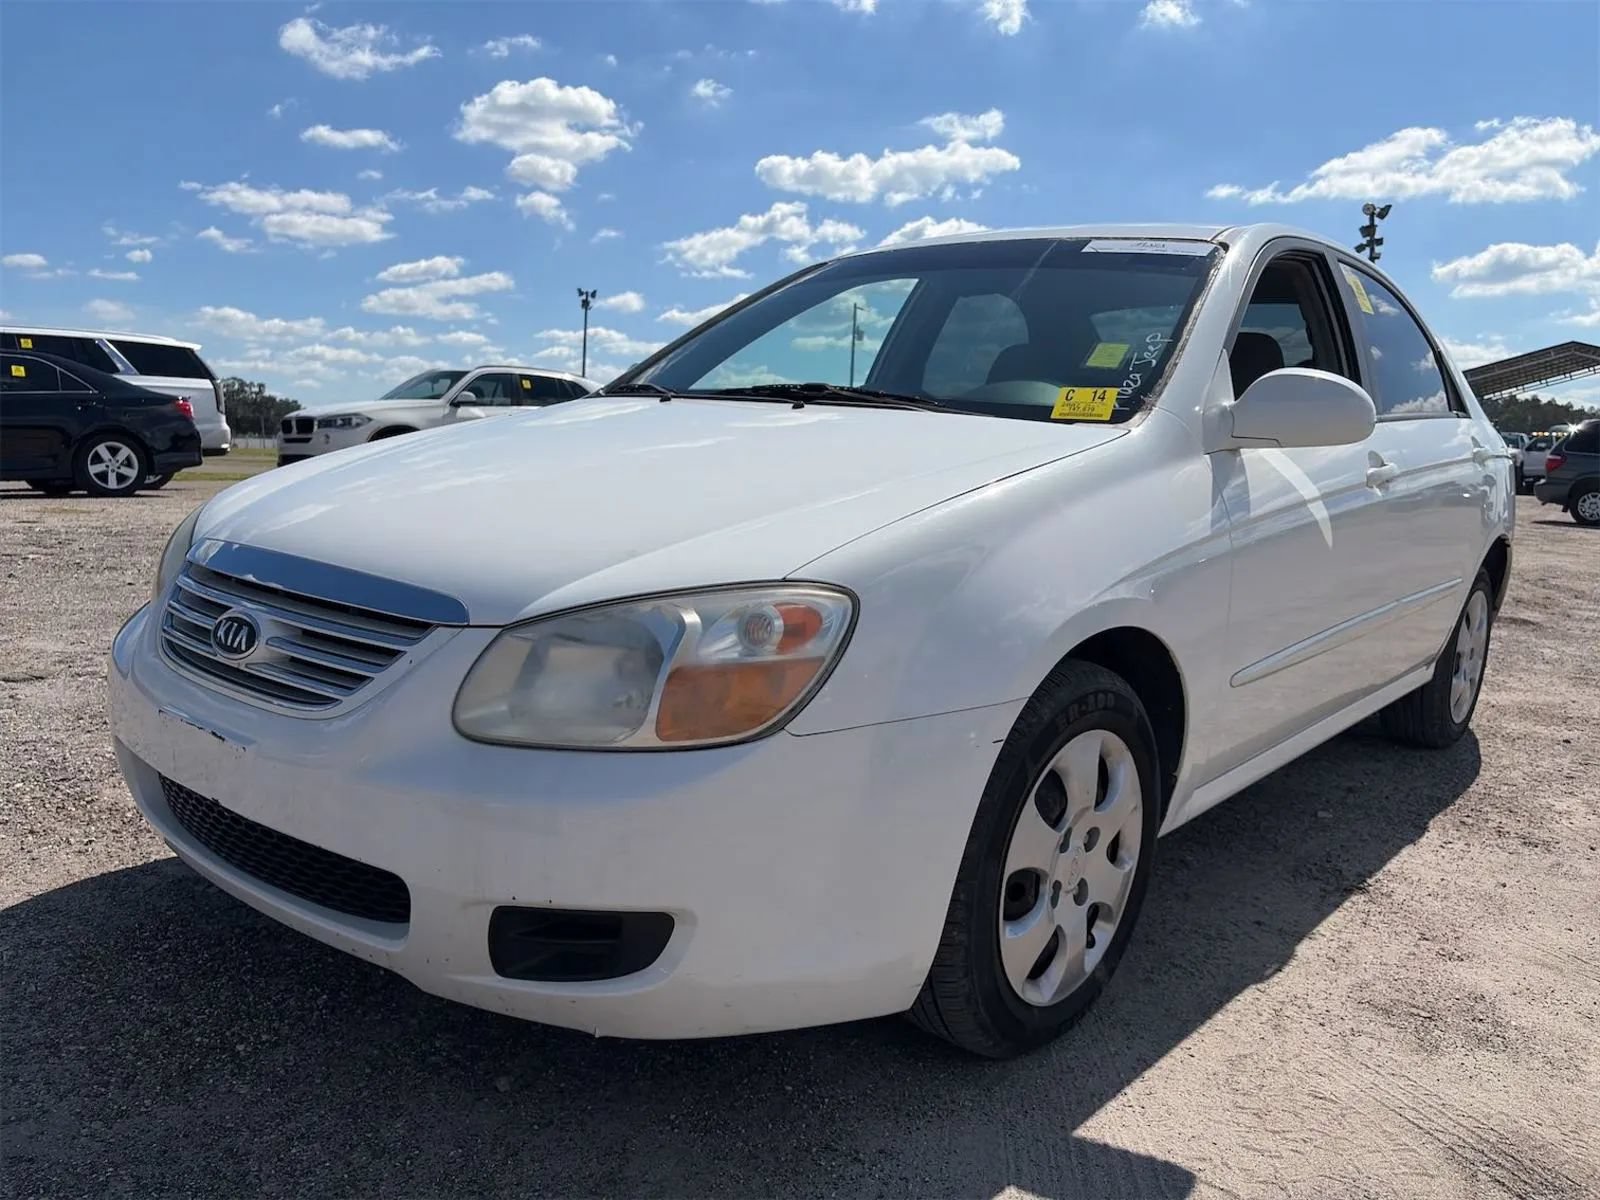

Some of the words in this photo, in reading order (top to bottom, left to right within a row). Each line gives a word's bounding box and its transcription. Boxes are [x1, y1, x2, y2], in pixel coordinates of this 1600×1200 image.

[1129, 332, 1173, 371] Jeep
[1065, 389, 1075, 401] C
[1092, 389, 1107, 402] 14
[217, 620, 248, 651] KIA
